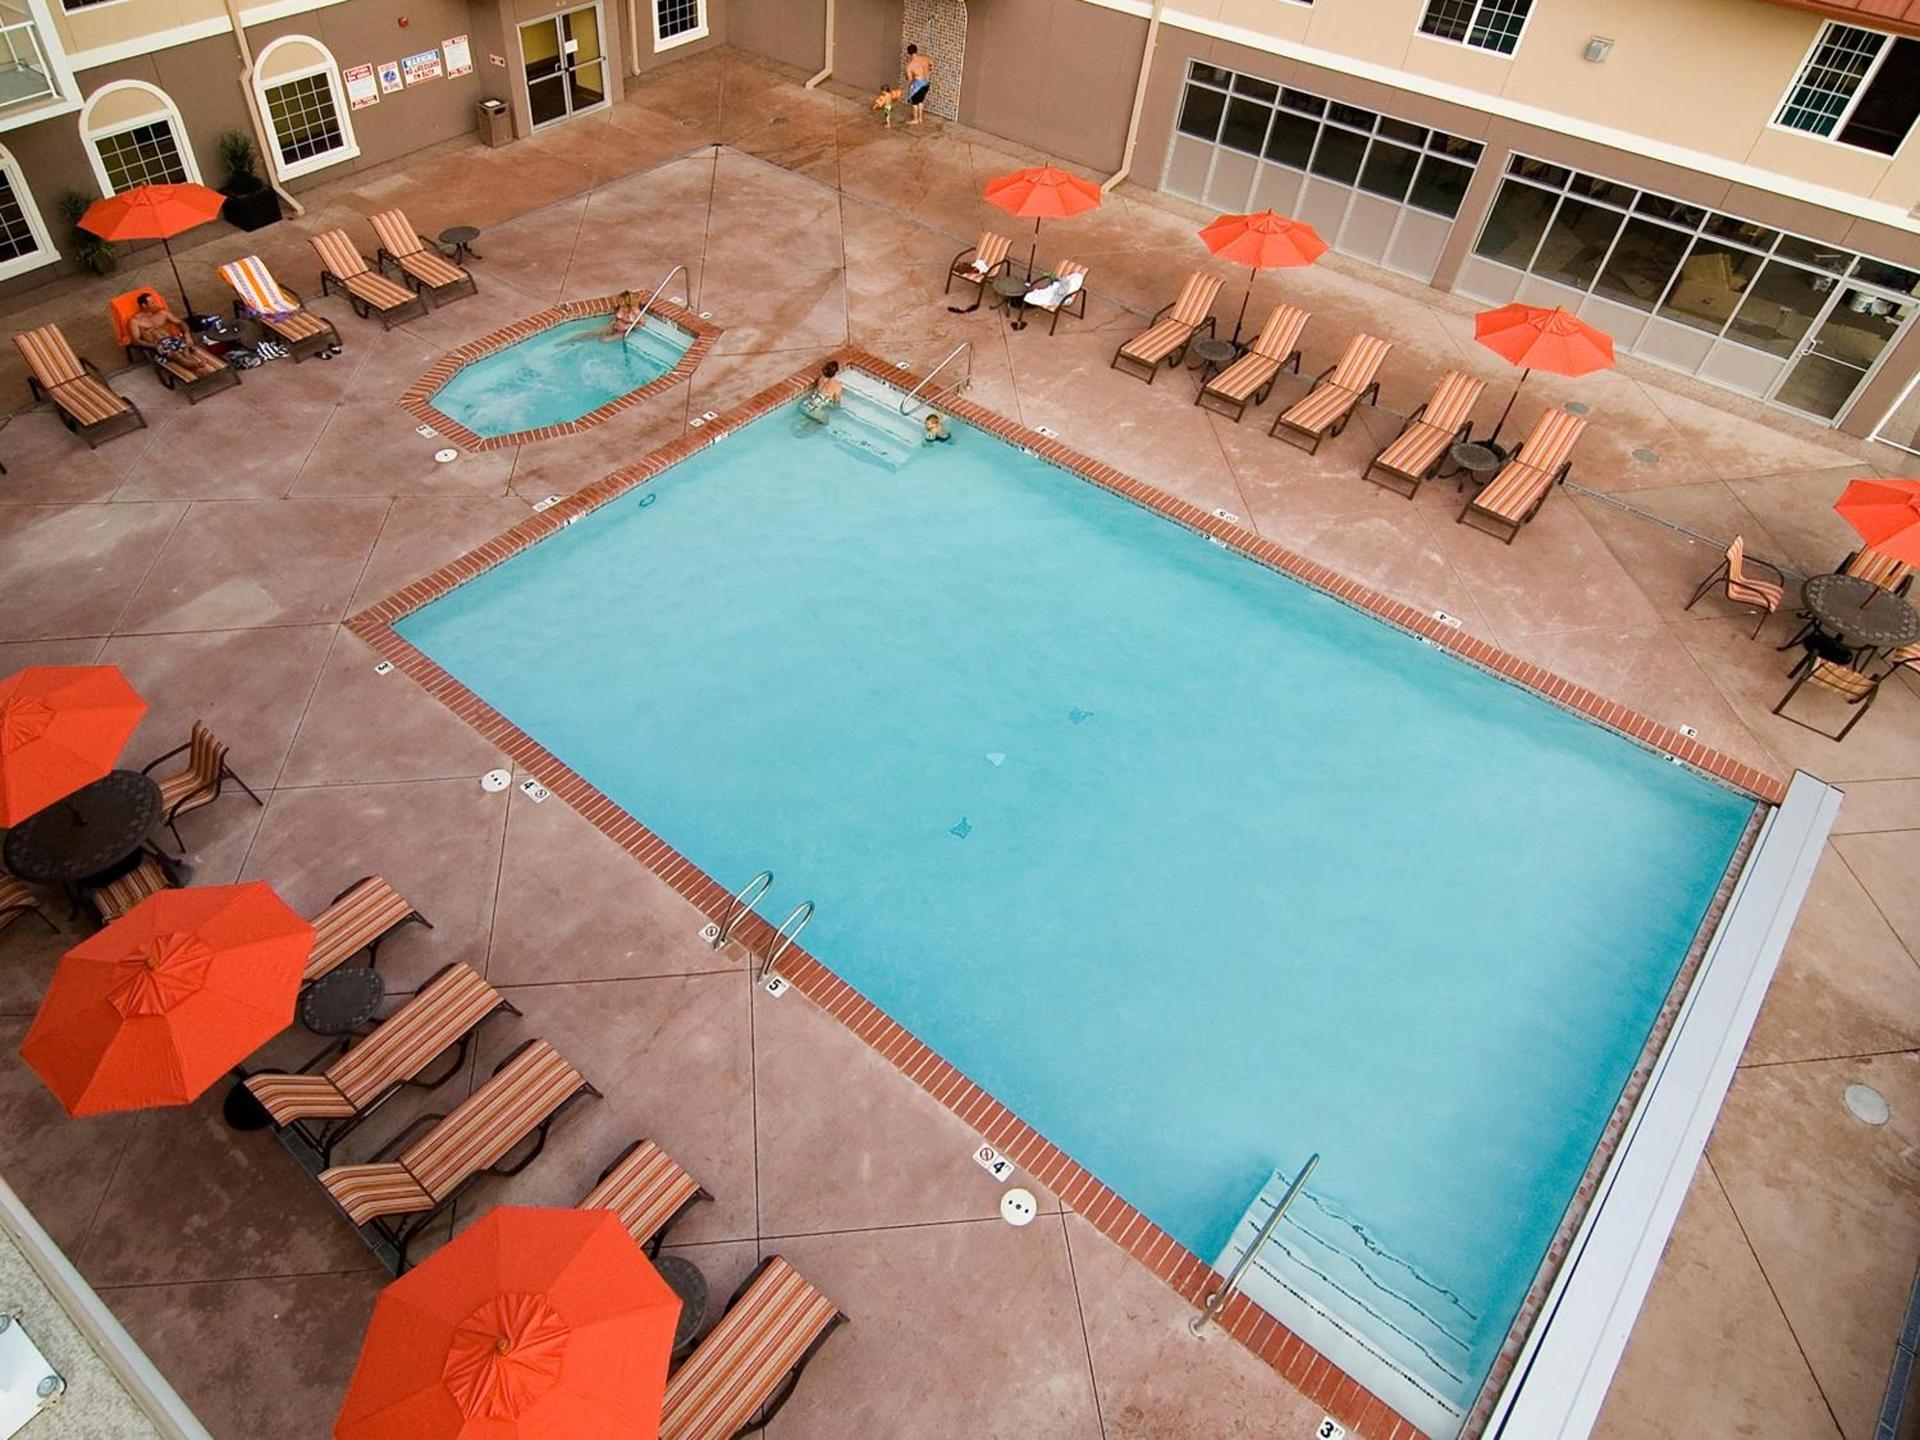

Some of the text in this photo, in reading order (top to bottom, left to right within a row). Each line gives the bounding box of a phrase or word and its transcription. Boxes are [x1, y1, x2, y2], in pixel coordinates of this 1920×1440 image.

[769, 980, 782, 991] 5
[993, 1161, 1006, 1174] 4
[1320, 1421, 1334, 1438] 3
